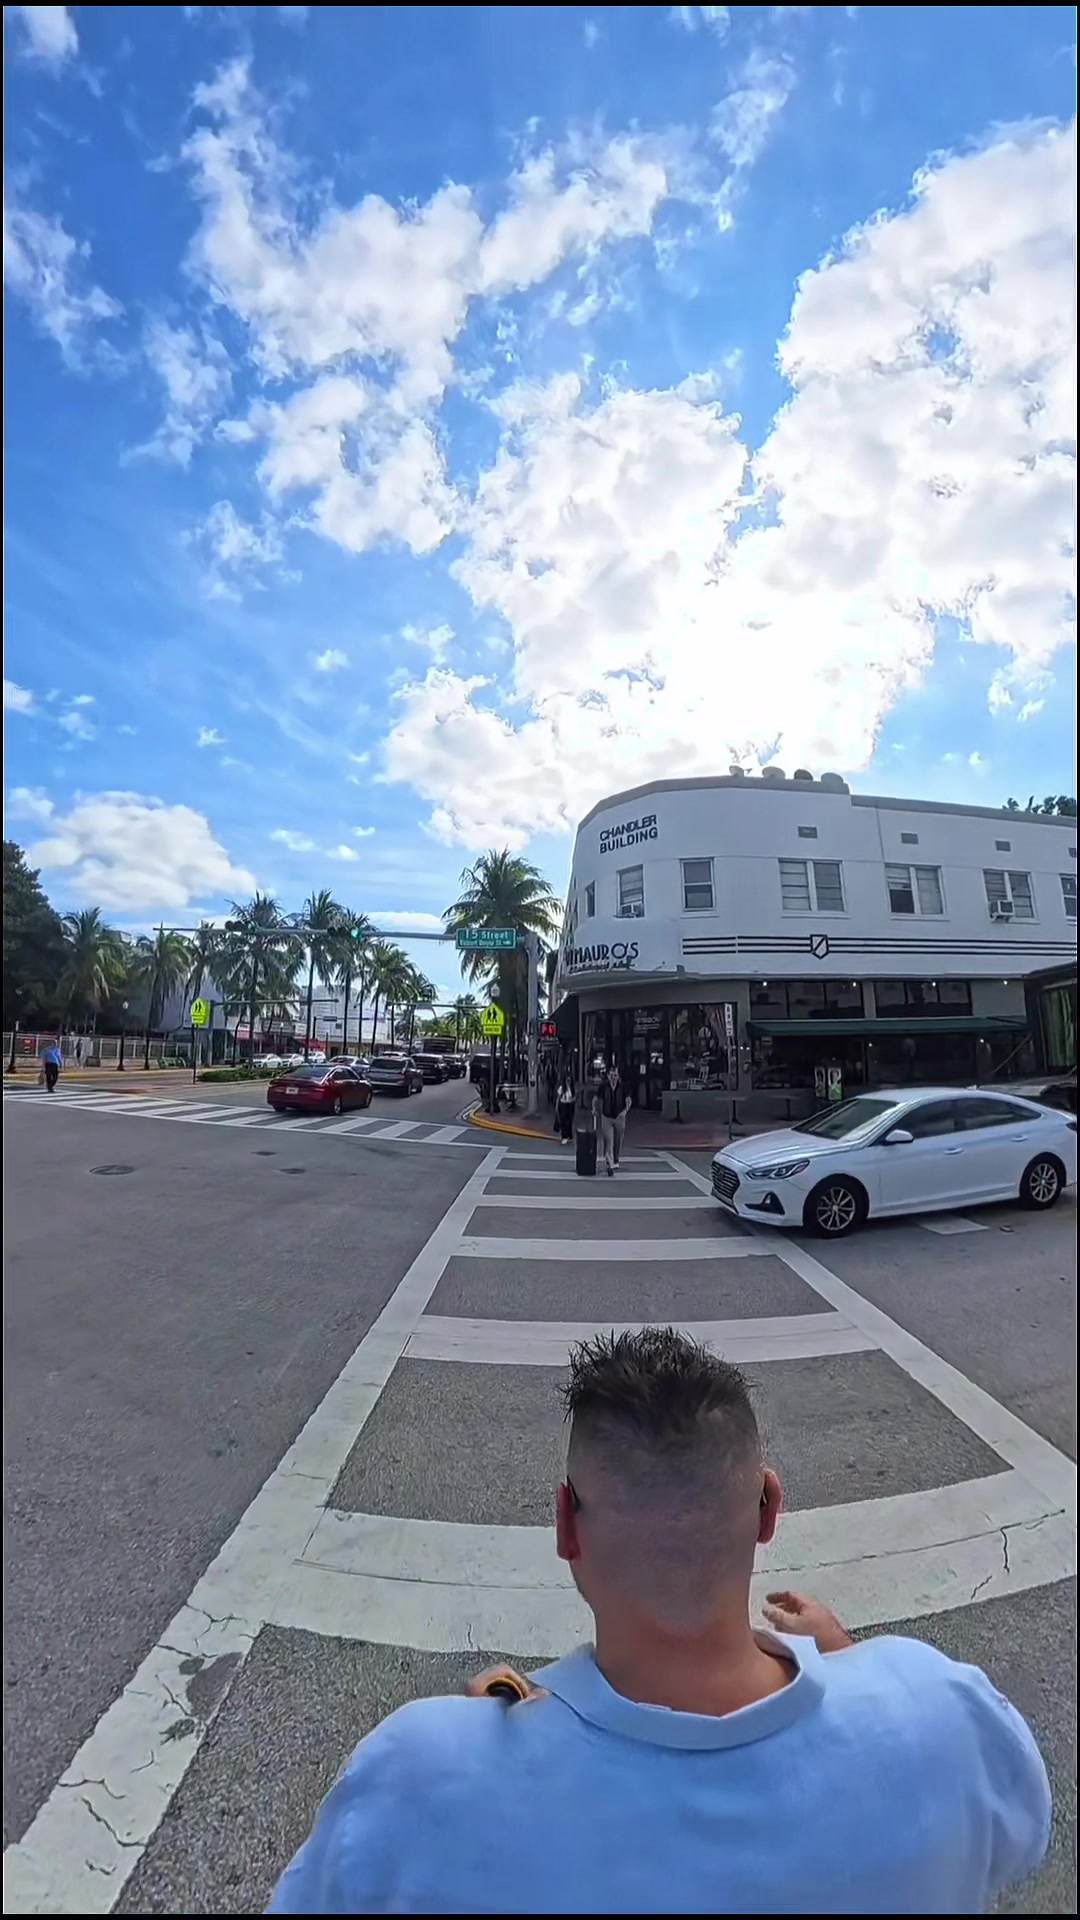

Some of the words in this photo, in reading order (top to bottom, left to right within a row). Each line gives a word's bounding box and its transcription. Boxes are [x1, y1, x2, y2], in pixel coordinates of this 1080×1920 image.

[599, 814, 658, 842] CHANDLER
[599, 827, 658, 854] BUILDING
[465, 929, 479, 939] 15
[481, 931, 509, 940] Street
